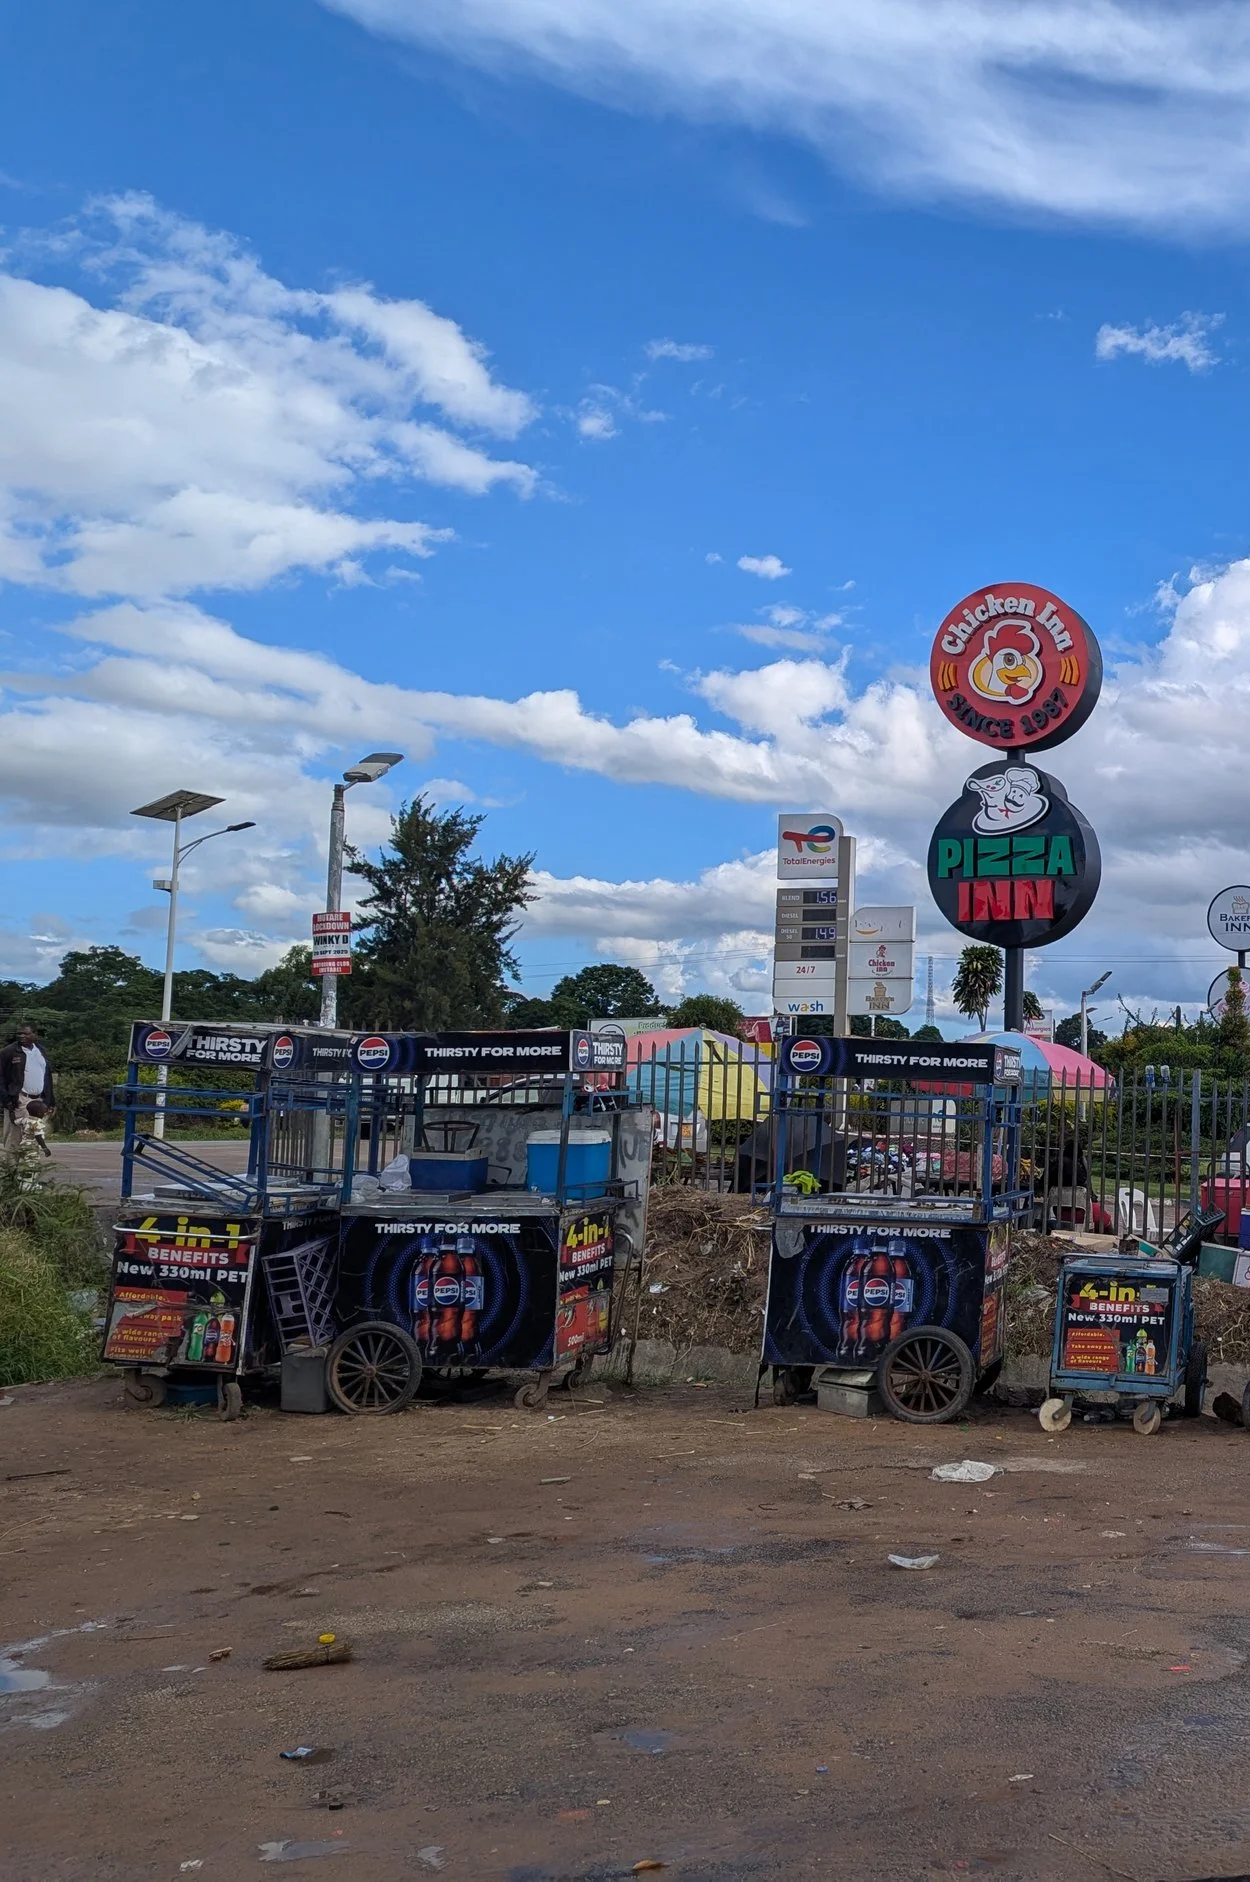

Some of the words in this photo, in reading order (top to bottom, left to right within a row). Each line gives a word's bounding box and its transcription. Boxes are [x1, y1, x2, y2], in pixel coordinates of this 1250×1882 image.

[941, 593, 1036, 656] Chicken
[1035, 601, 1074, 652] Inn
[946, 691, 1015, 739] SINCE
[1020, 686, 1070, 736] 1987
[782, 857, 836, 866] TotalEnergies
[937, 835, 1077, 878] PIZZA
[957, 879, 1055, 922] INN
[313, 935, 340, 945] WINKY
[342, 935, 349, 944] D
[868, 959, 896, 967] Chicken
[796, 966, 816, 974] 24/7
[788, 1001, 824, 1012] wash
[187, 1035, 268, 1053] THIRSTY
[592, 1042, 623, 1057] THIRSTY
[185, 1051, 217, 1060] FOR
[218, 1052, 262, 1063] MORE
[274, 1048, 293, 1056] PEPSI
[312, 1048, 342, 1057] THIRSTY
[360, 1049, 388, 1058] PEPSI
[424, 1048, 478, 1058] THIRSTY
[481, 1047, 514, 1057] FOR
[516, 1046, 562, 1056] MORE
[792, 1051, 821, 1061] PEPSI
[593, 1056, 606, 1064] FOR
[855, 1053, 907, 1065] THIRSTY
[909, 1056, 941, 1066] FOR
[943, 1057, 988, 1068] MORE
[375, 1223, 431, 1234] THIRSTY
[434, 1223, 469, 1234] FOR
[471, 1223, 521, 1234] MORE
[810, 1224, 865, 1236] THIRSTY
[866, 1226, 901, 1237] FOR
[902, 1227, 952, 1239] MORE
[147, 1247, 230, 1265] BENEFITS
[571, 1242, 606, 1264] BENEFITS
[116, 1261, 154, 1275] New
[159, 1264, 212, 1280] 330ml
[216, 1268, 250, 1284] PET
[559, 1269, 575, 1283] New
[576, 1262, 599, 1278] 330ml
[600, 1255, 613, 1270] PET
[434, 1287, 459, 1295] PEPSI
[864, 1288, 889, 1297] PEPSI
[1089, 1302, 1150, 1313] BENEFITS
[1067, 1312, 1095, 1322] New
[1099, 1314, 1137, 1324] 330ml
[1141, 1316, 1166, 1326] PET
